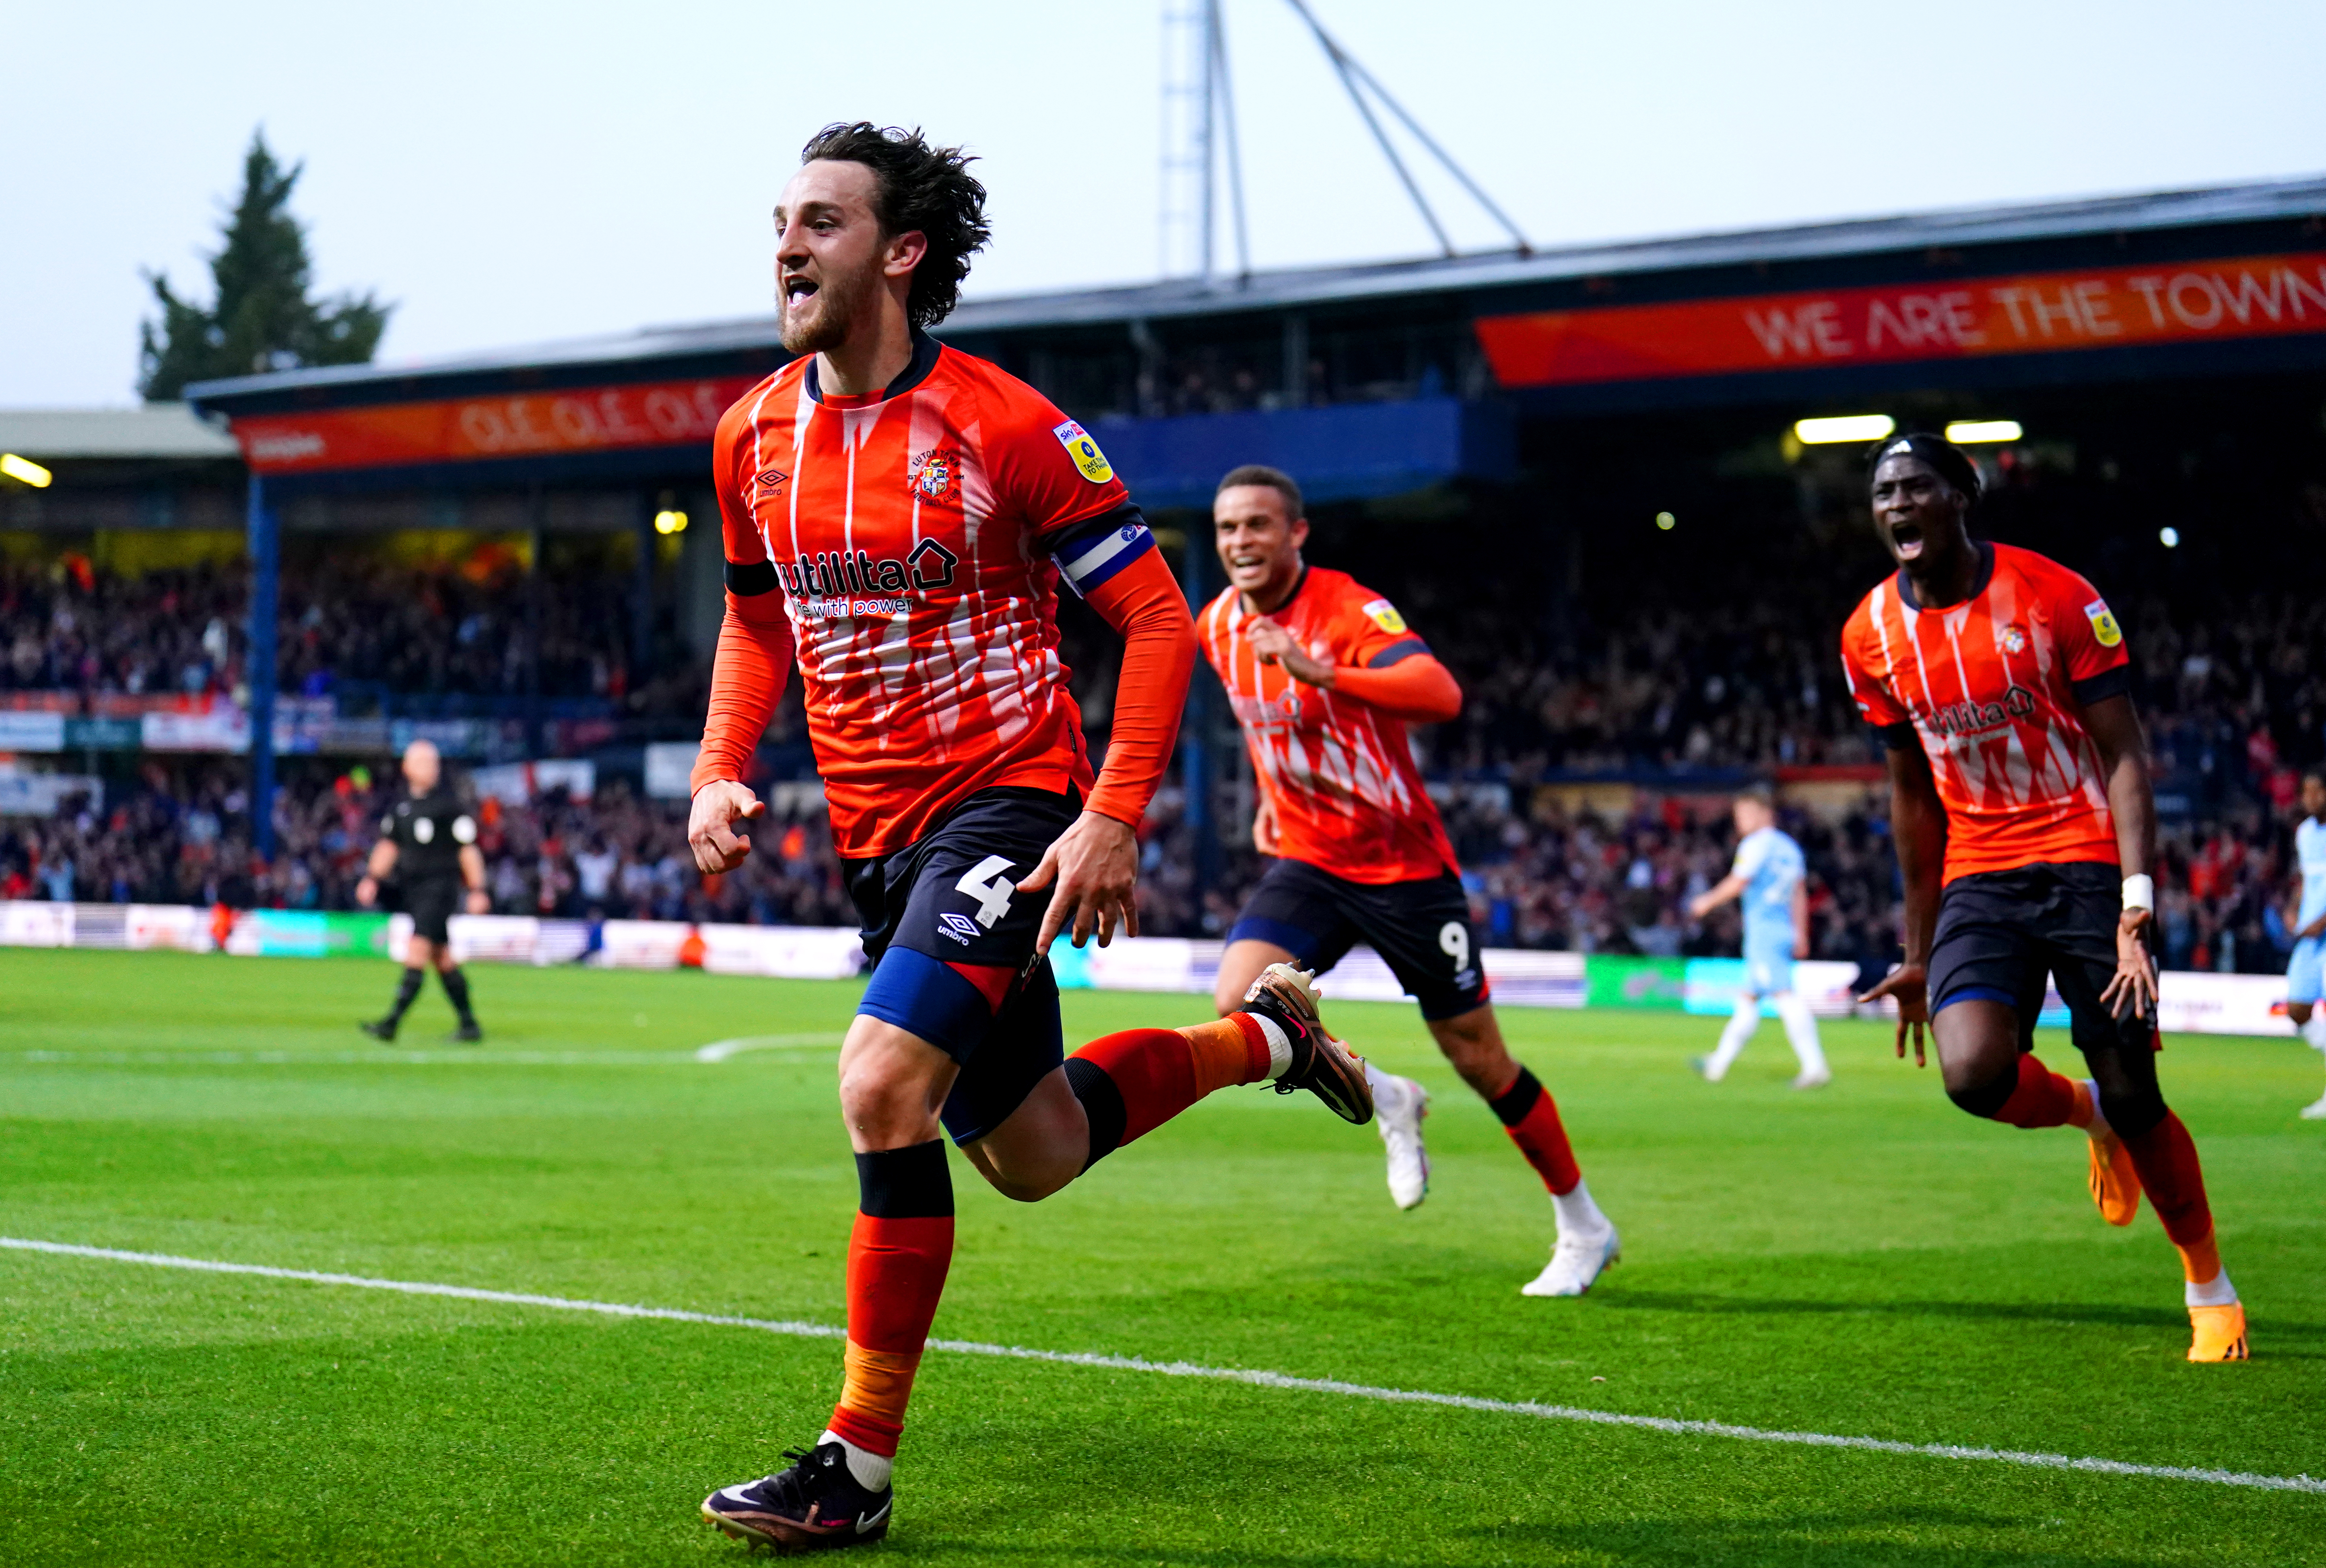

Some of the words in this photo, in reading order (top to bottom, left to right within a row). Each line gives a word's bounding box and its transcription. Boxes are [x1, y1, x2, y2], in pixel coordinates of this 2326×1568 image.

[1743, 300, 1854, 359] WE
[1866, 290, 1988, 351] ARE
[1989, 280, 2122, 339] THE
[2127, 264, 2326, 330] TOWN
[1060, 429, 1074, 440] sky
[912, 449, 937, 467] LUTON
[940, 449, 961, 468] TOWN
[1083, 459, 1097, 470] TAKE
[760, 487, 782, 497] umbro
[910, 488, 941, 507] FOOTBALL
[943, 488, 960, 503] CLUB
[782, 550, 909, 596] utilita
[813, 598, 848, 617] with
[854, 598, 913, 618] power
[955, 855, 1017, 929] 4
[937, 925, 969, 946] umbro
[1439, 921, 1469, 973] 9
